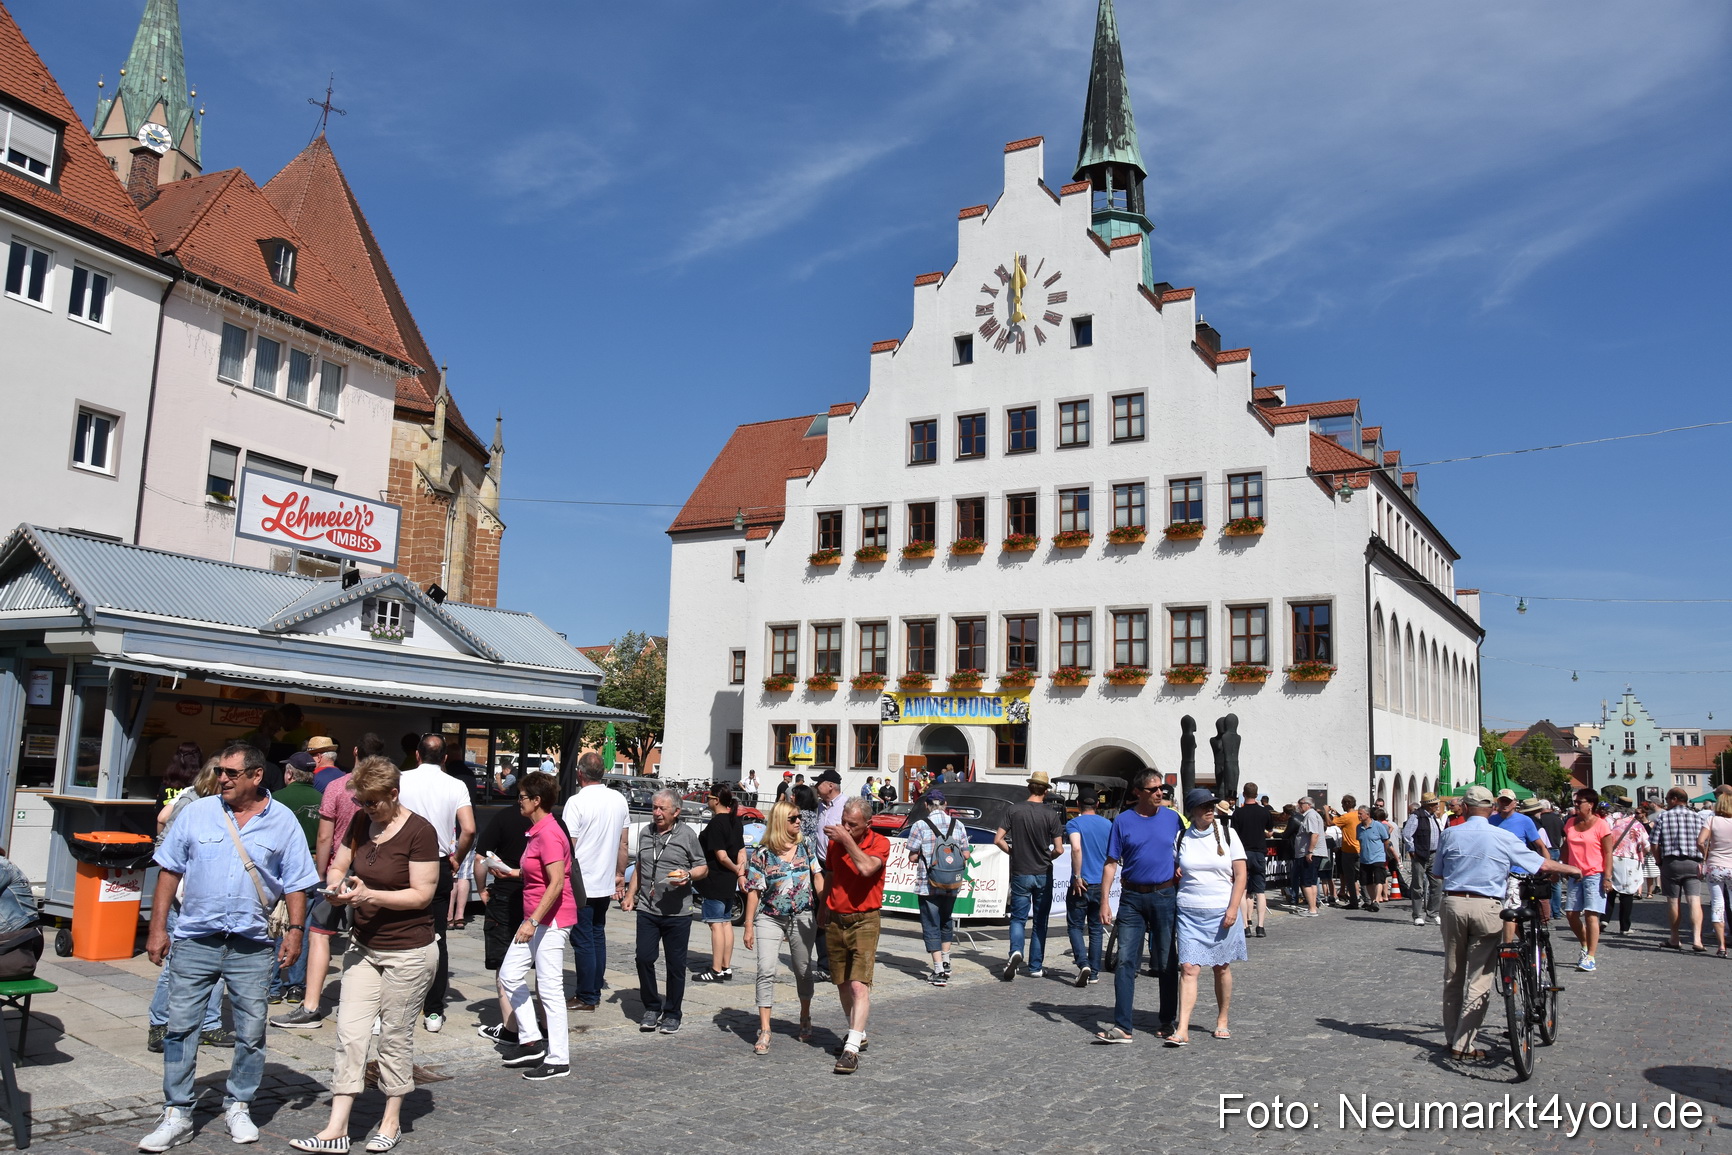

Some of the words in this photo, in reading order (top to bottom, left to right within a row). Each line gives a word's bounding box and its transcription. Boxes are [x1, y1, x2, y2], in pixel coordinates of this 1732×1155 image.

[261, 491, 374, 541] Lehmeier's
[332, 530, 375, 551] IMBISS
[903, 697, 1003, 717] ANMELDUNG
[792, 736, 813, 754] WC
[889, 894, 901, 903] 52
